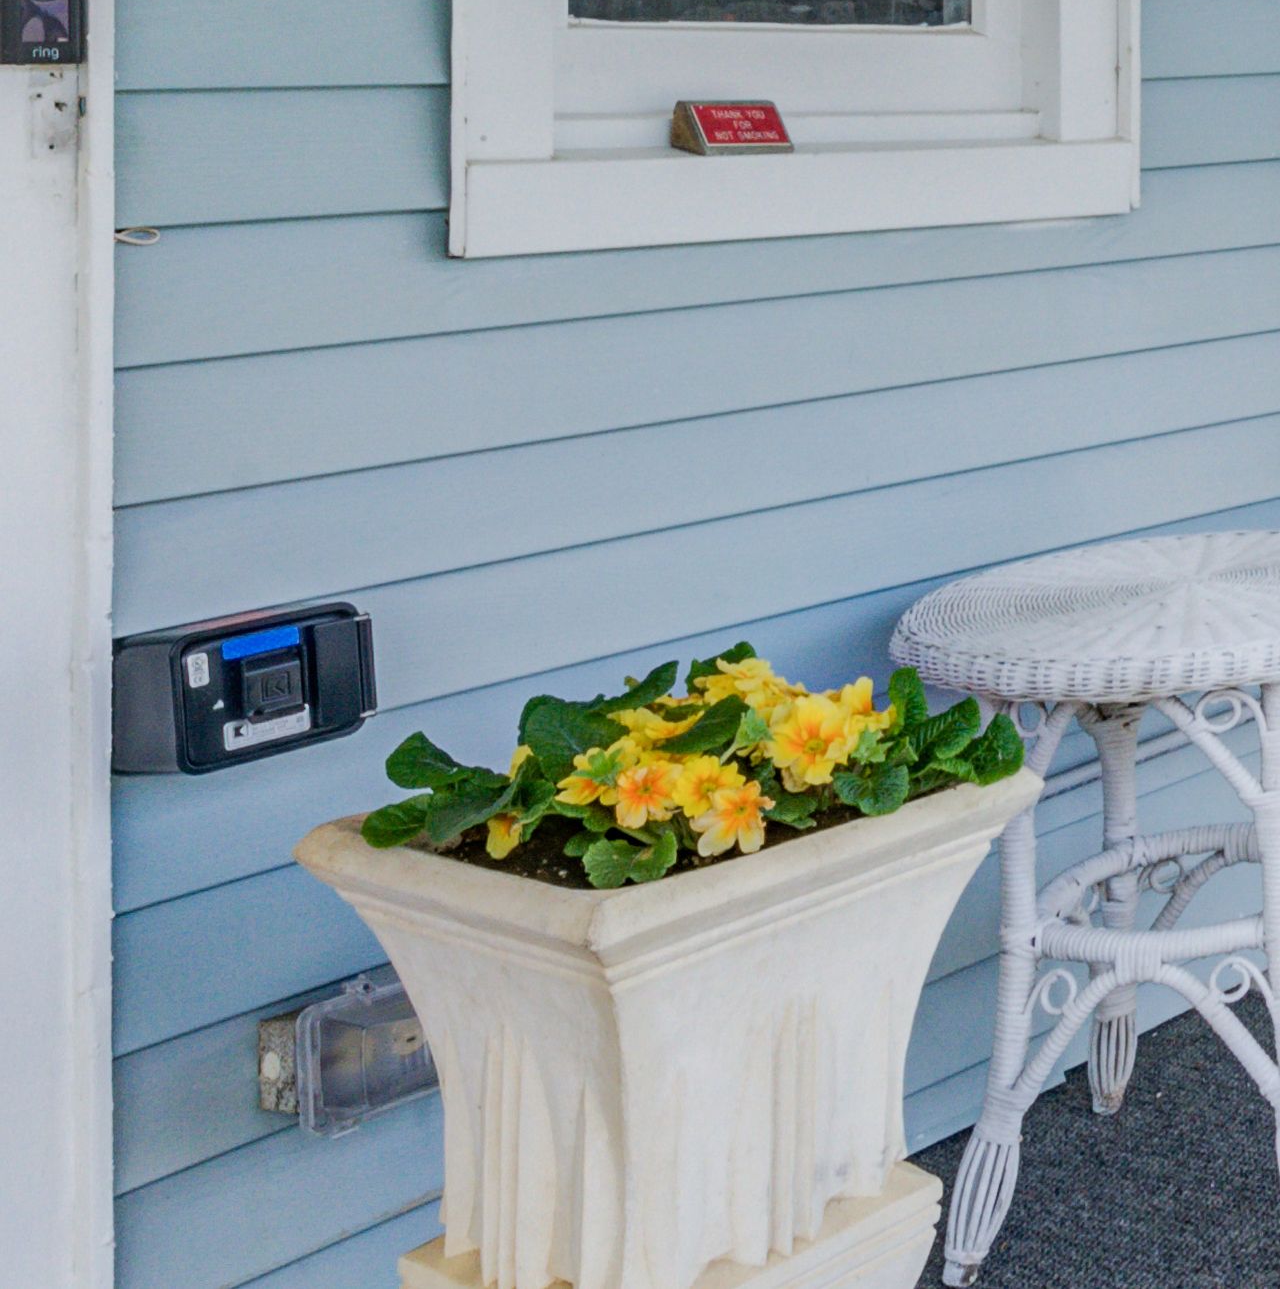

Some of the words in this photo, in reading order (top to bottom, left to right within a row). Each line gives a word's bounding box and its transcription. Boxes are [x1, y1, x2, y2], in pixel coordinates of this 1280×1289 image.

[32, 46, 60, 60] ring
[711, 109, 743, 119] THANK
[745, 109, 766, 119] YOU
[733, 120, 752, 129] FOR
[714, 131, 735, 140] NOT
[737, 130, 780, 141] SMOKING
